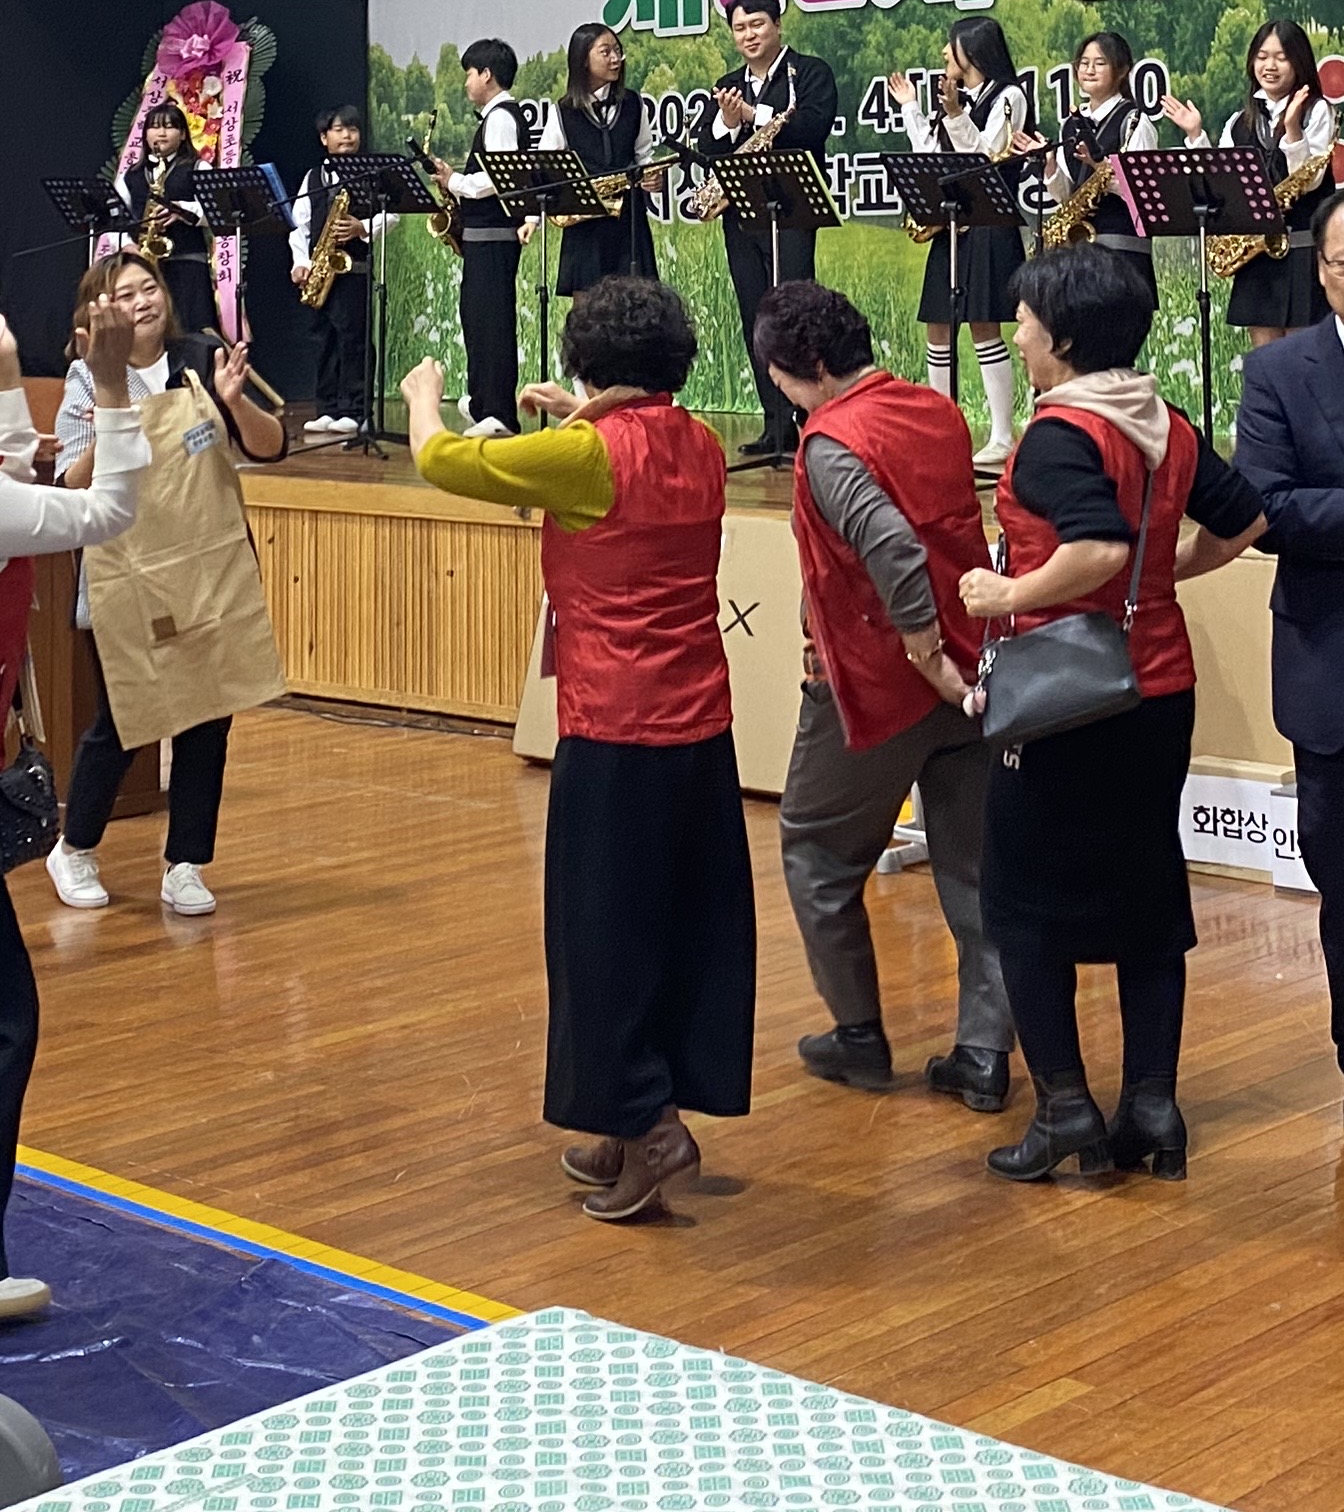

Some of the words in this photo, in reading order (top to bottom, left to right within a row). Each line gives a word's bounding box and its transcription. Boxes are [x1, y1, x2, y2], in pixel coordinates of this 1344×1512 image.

[225, 69, 244, 85] 祝
[1193, 805, 1269, 844] 화합상
[1272, 828, 1303, 860] 인
